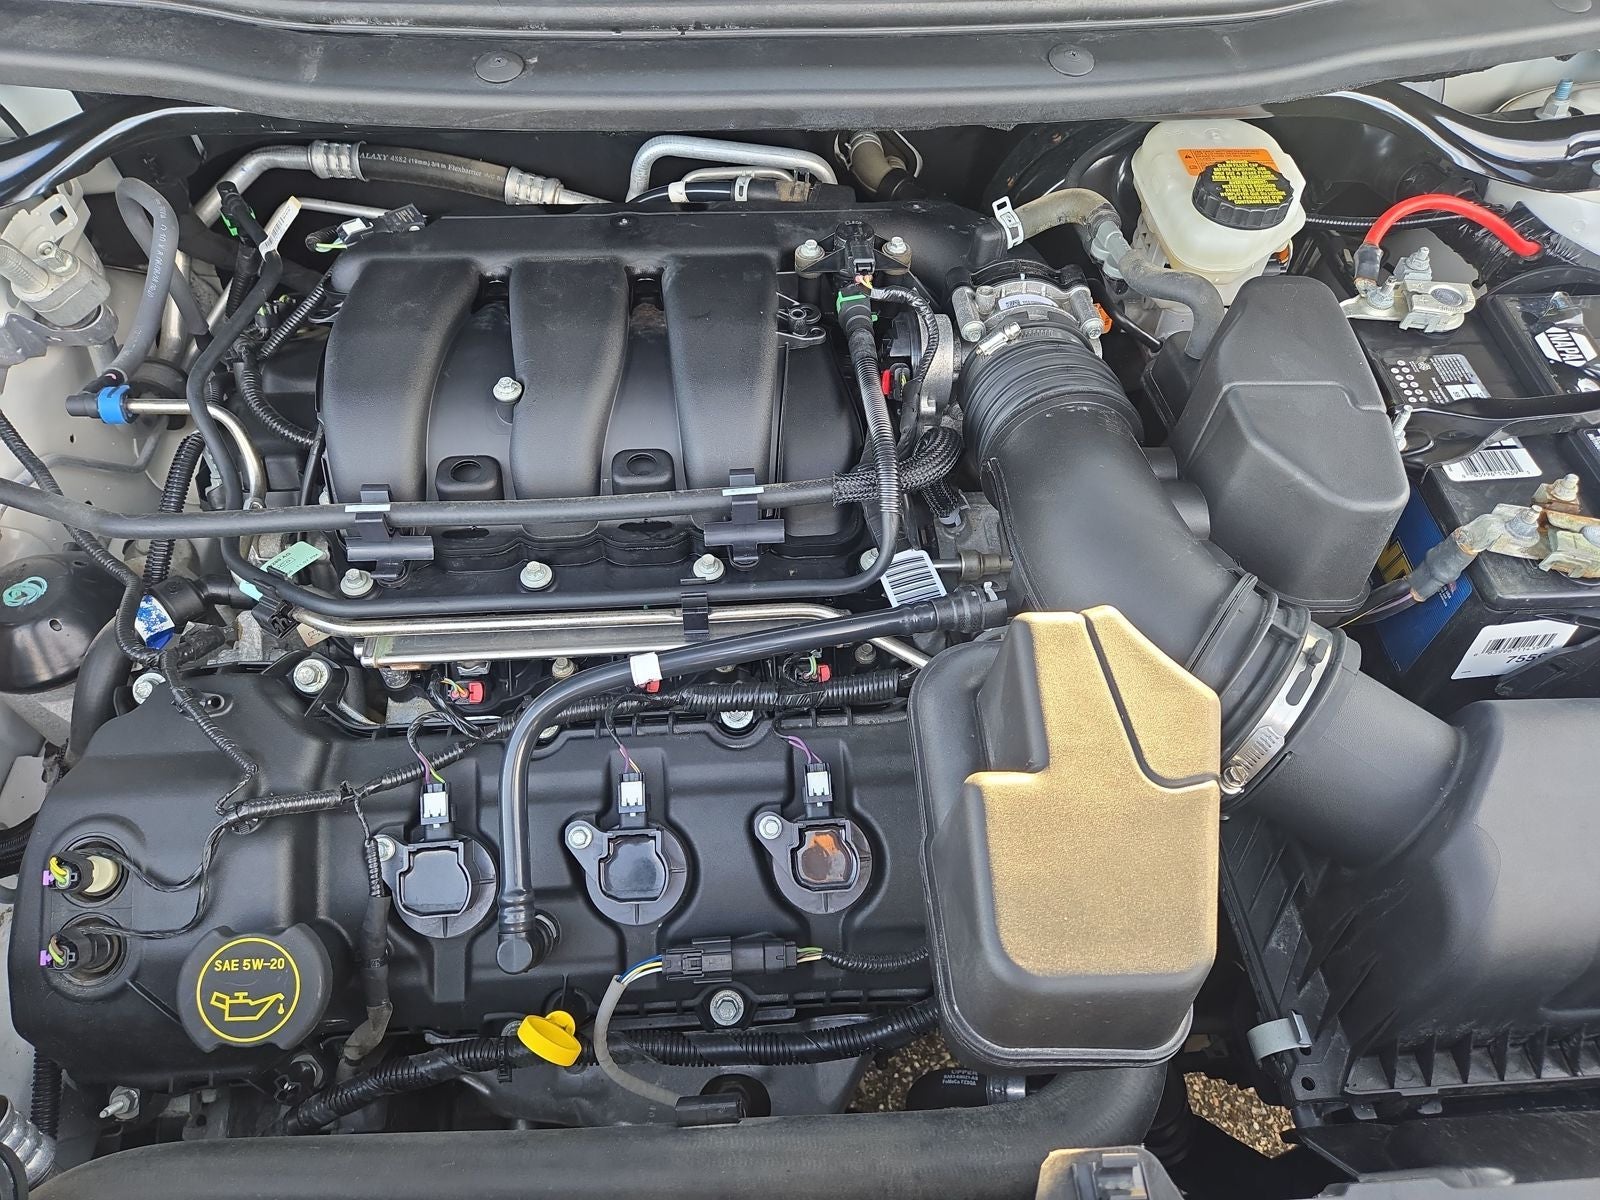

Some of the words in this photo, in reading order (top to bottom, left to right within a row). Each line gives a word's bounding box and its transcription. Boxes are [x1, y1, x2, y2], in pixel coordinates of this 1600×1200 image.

[360, 152, 389, 161] ALAXY
[448, 163, 482, 177] Flexbarrier
[1547, 332, 1586, 361] NAPA
[214, 959, 239, 971] SAE
[242, 958, 285, 970] 5W-20
